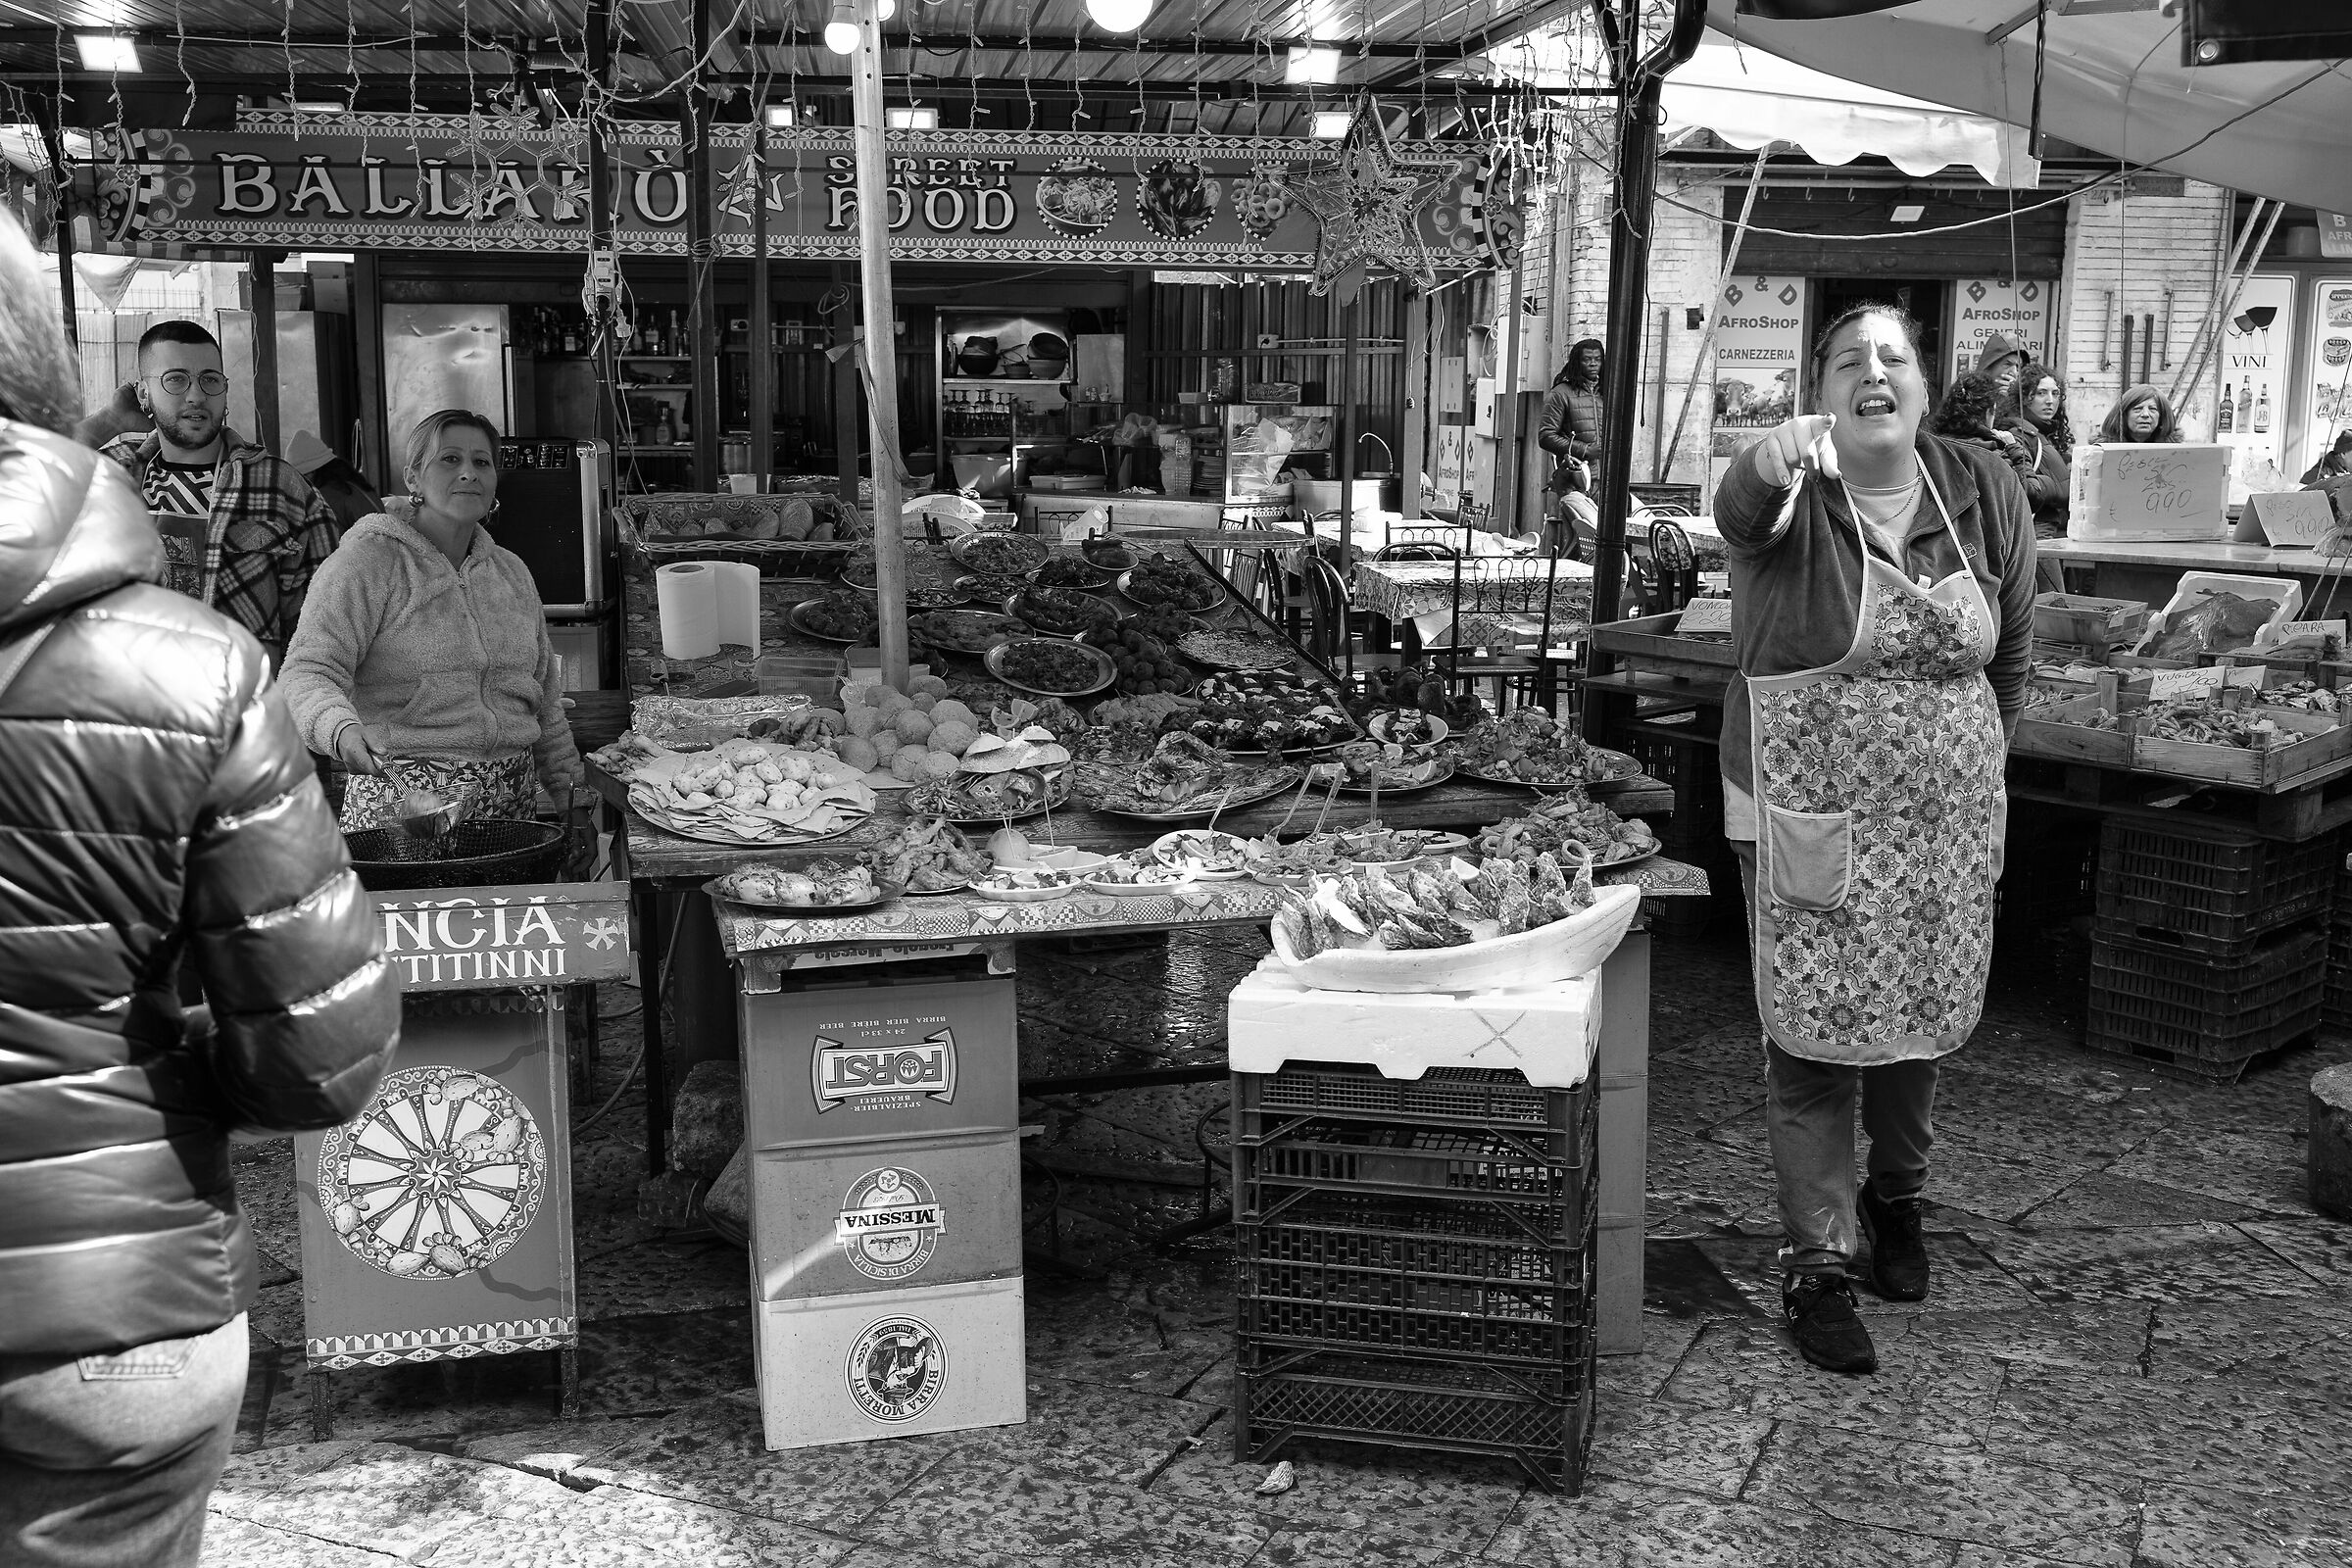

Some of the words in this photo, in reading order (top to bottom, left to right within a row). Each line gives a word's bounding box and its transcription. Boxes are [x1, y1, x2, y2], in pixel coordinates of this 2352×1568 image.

[827, 156, 1014, 186] SREET
[2328, 230, 2352, 241] AFR
[1724, 284, 1743, 307] B
[1754, 275, 1769, 292] &
[1778, 283, 1797, 306] D
[1966, 280, 1986, 304] B
[2019, 281, 2039, 302] D
[1719, 348, 1795, 361] CARNEZZERIA
[2232, 355, 2267, 368] VINI
[379, 895, 567, 953] NCIA
[391, 948, 566, 983] TITINNI
[851, 1019, 880, 1029] BIÈRE
[886, 1017, 909, 1026] BIER
[915, 1015, 947, 1024] BIRRA
[825, 1051, 943, 1089] FORST
[850, 1101, 921, 1112] SPEZIALBIER-
[858, 1095, 911, 1104] BRAUEREI
[855, 1254, 887, 1277] SICILIA
[900, 1249, 930, 1274] BIRRA
[853, 1376, 906, 1416] MORETTI
[906, 1368, 940, 1410] BIRRA
